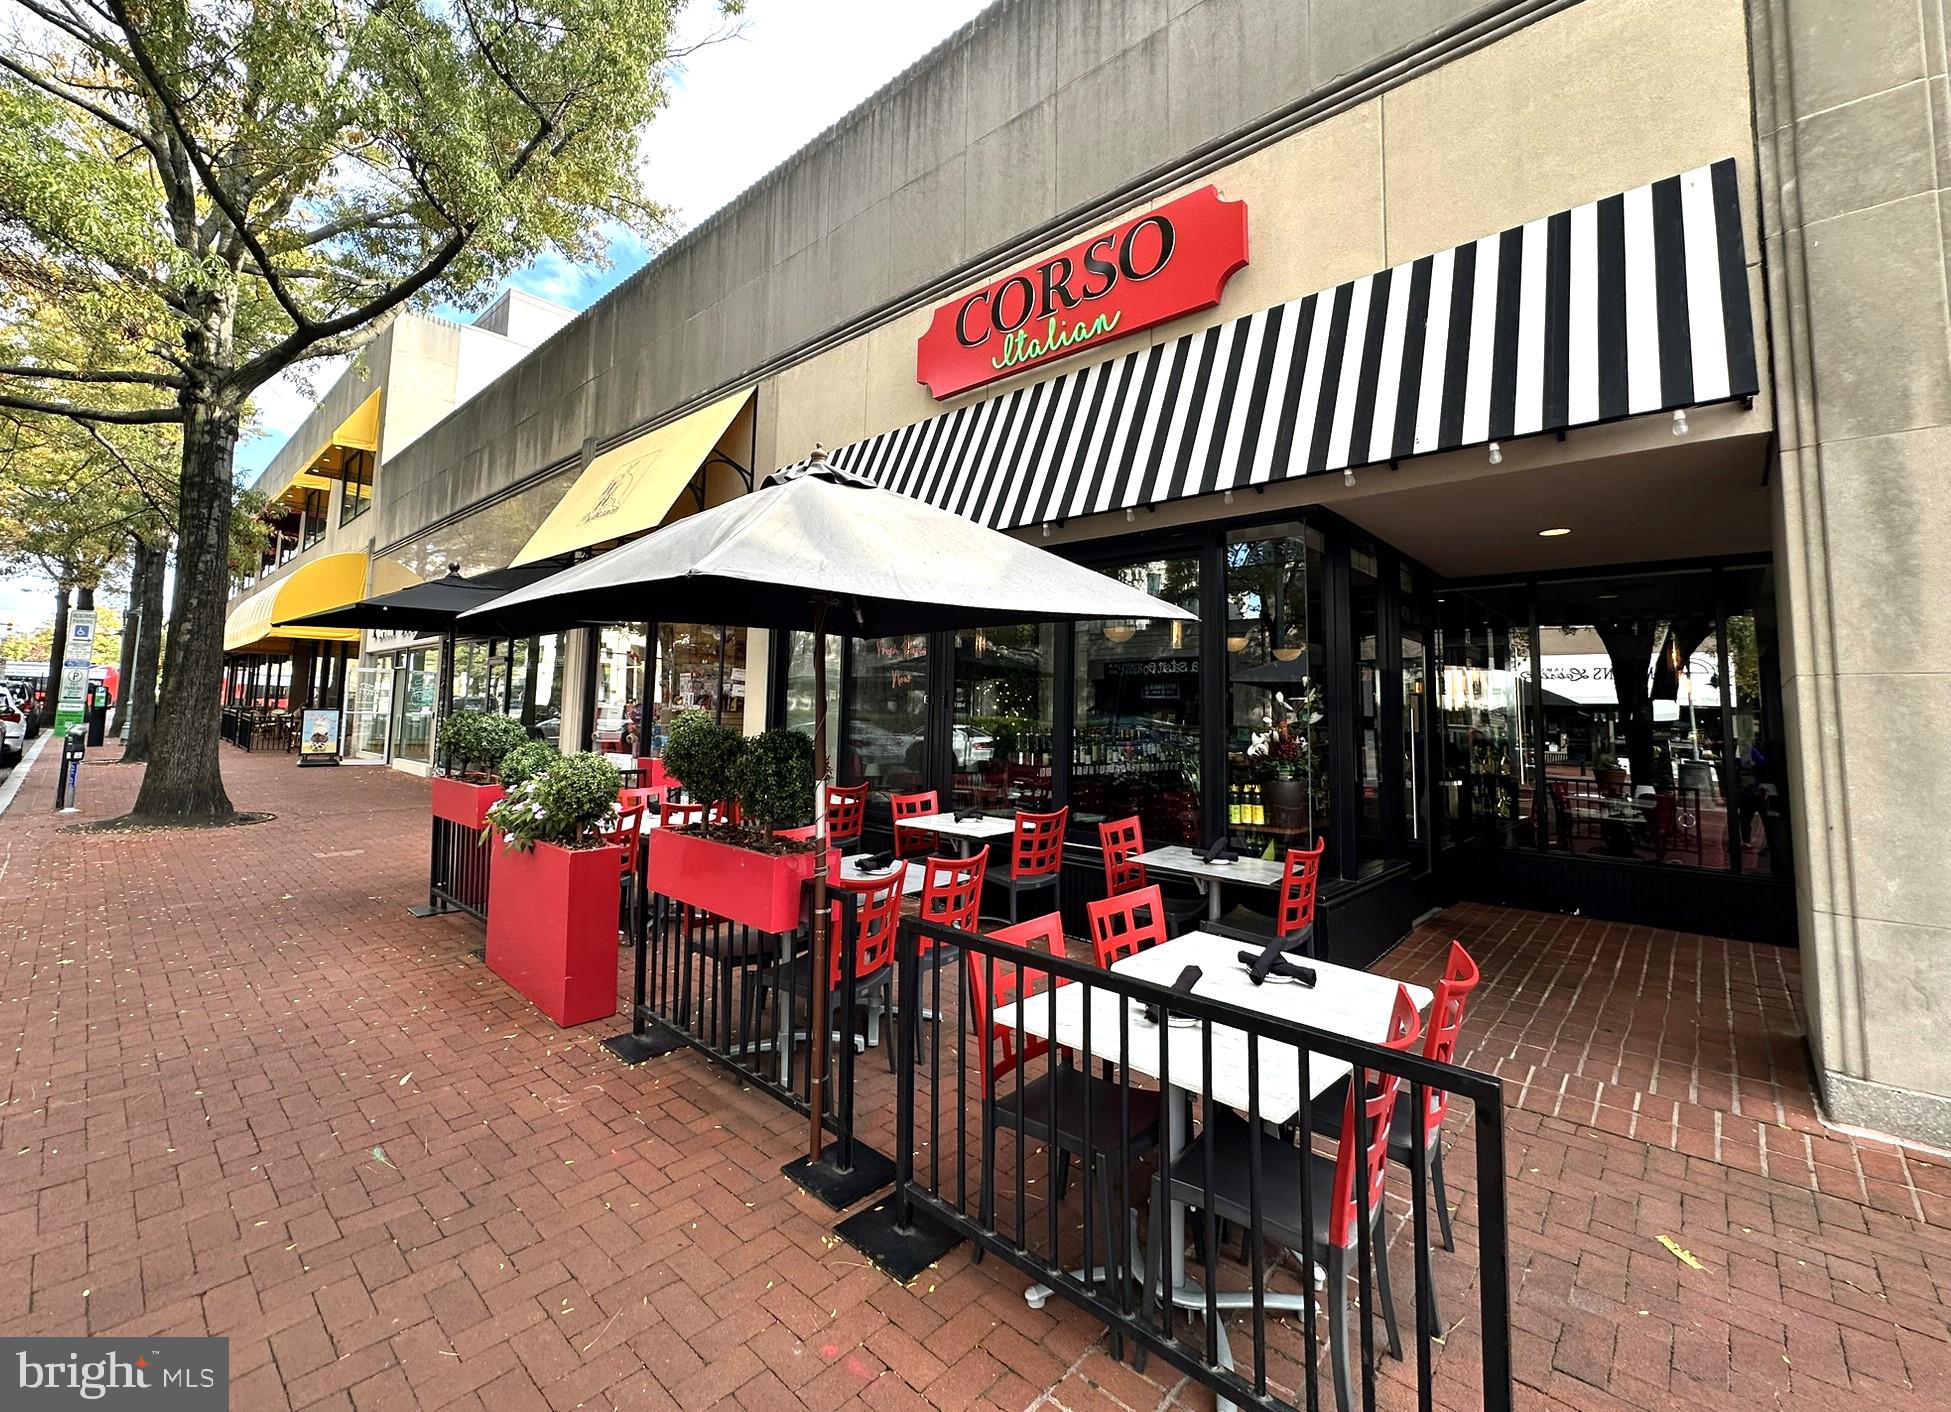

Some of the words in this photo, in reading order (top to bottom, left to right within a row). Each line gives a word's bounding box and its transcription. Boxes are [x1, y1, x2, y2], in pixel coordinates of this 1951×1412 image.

[955, 215, 1177, 348] CORSO
[992, 310, 1122, 370] Italian
[73, 672, 80, 681] P
